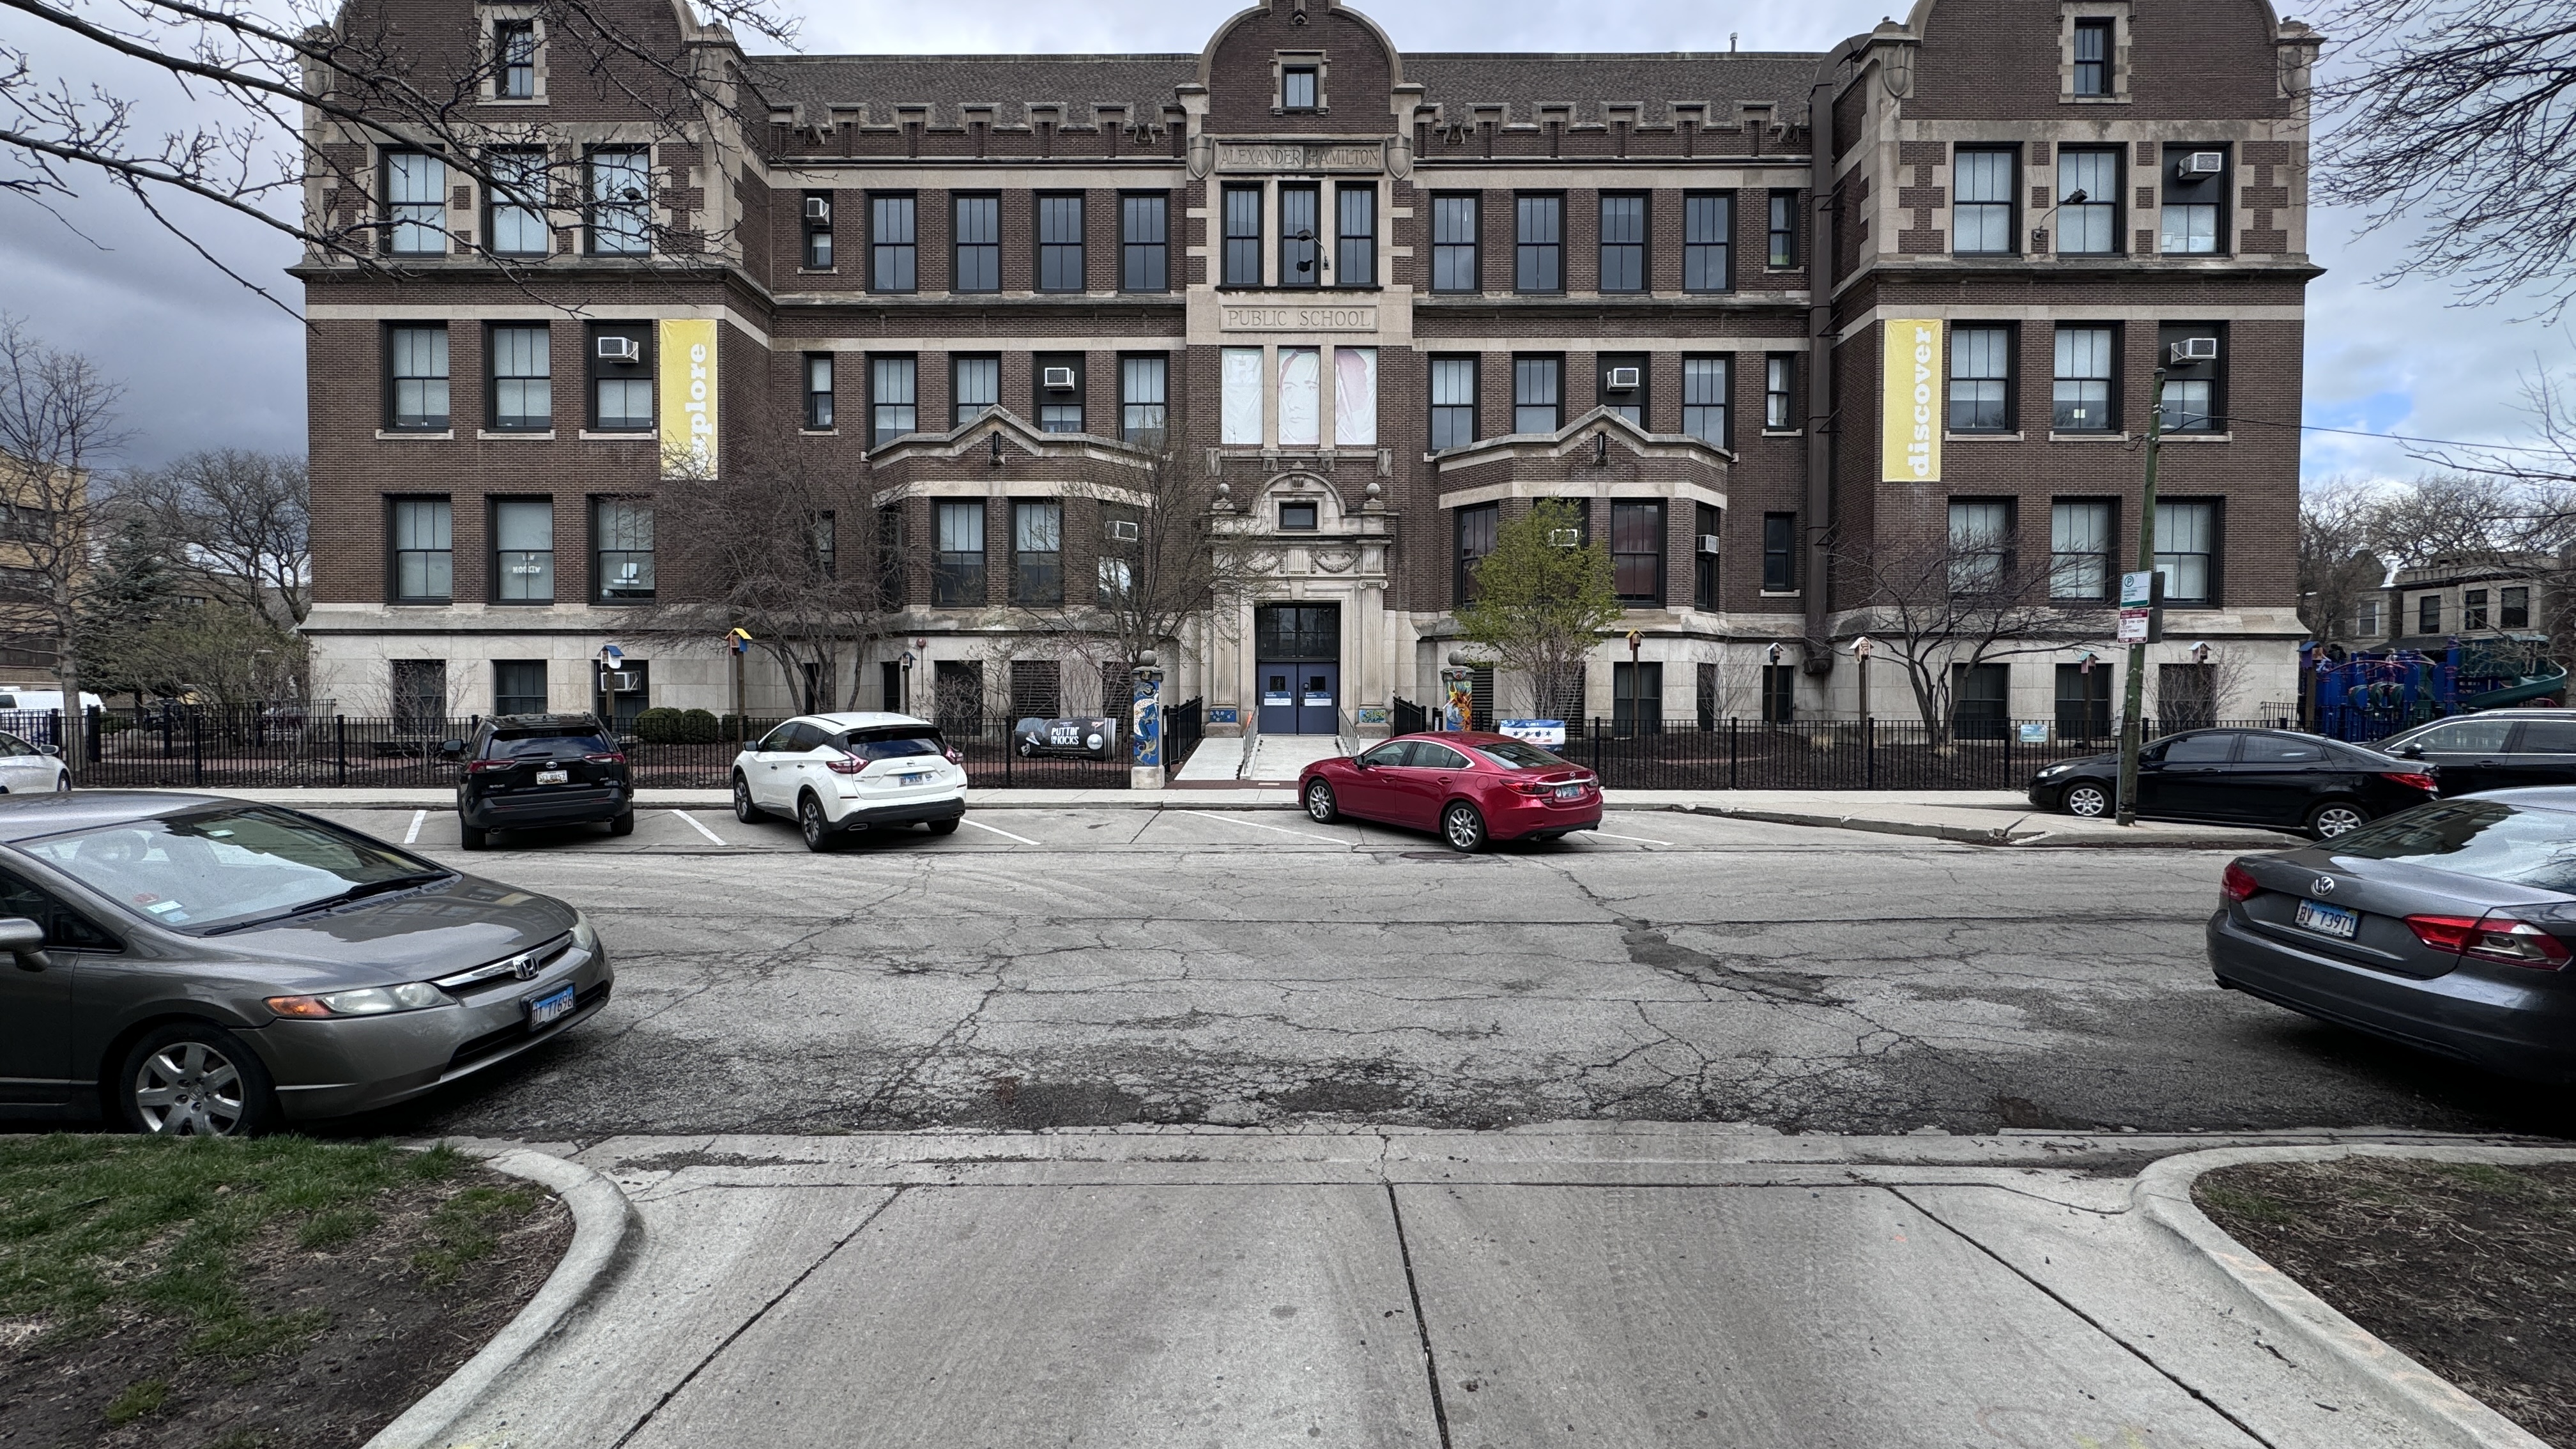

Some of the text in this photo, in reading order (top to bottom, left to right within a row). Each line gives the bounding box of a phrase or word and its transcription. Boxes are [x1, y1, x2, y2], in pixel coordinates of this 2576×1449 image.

[1220, 149, 1378, 165] ALEXANDER HAMILTON
[1227, 310, 1371, 326] PUBLIC SCHOOL
[1908, 326, 1932, 477] discover
[1051, 727, 1080, 736] PUTTIN'
[1057, 735, 1080, 745] KICKS
[2299, 906, 2354, 933] BV 73971
[546, 992, 573, 1017] 77696
